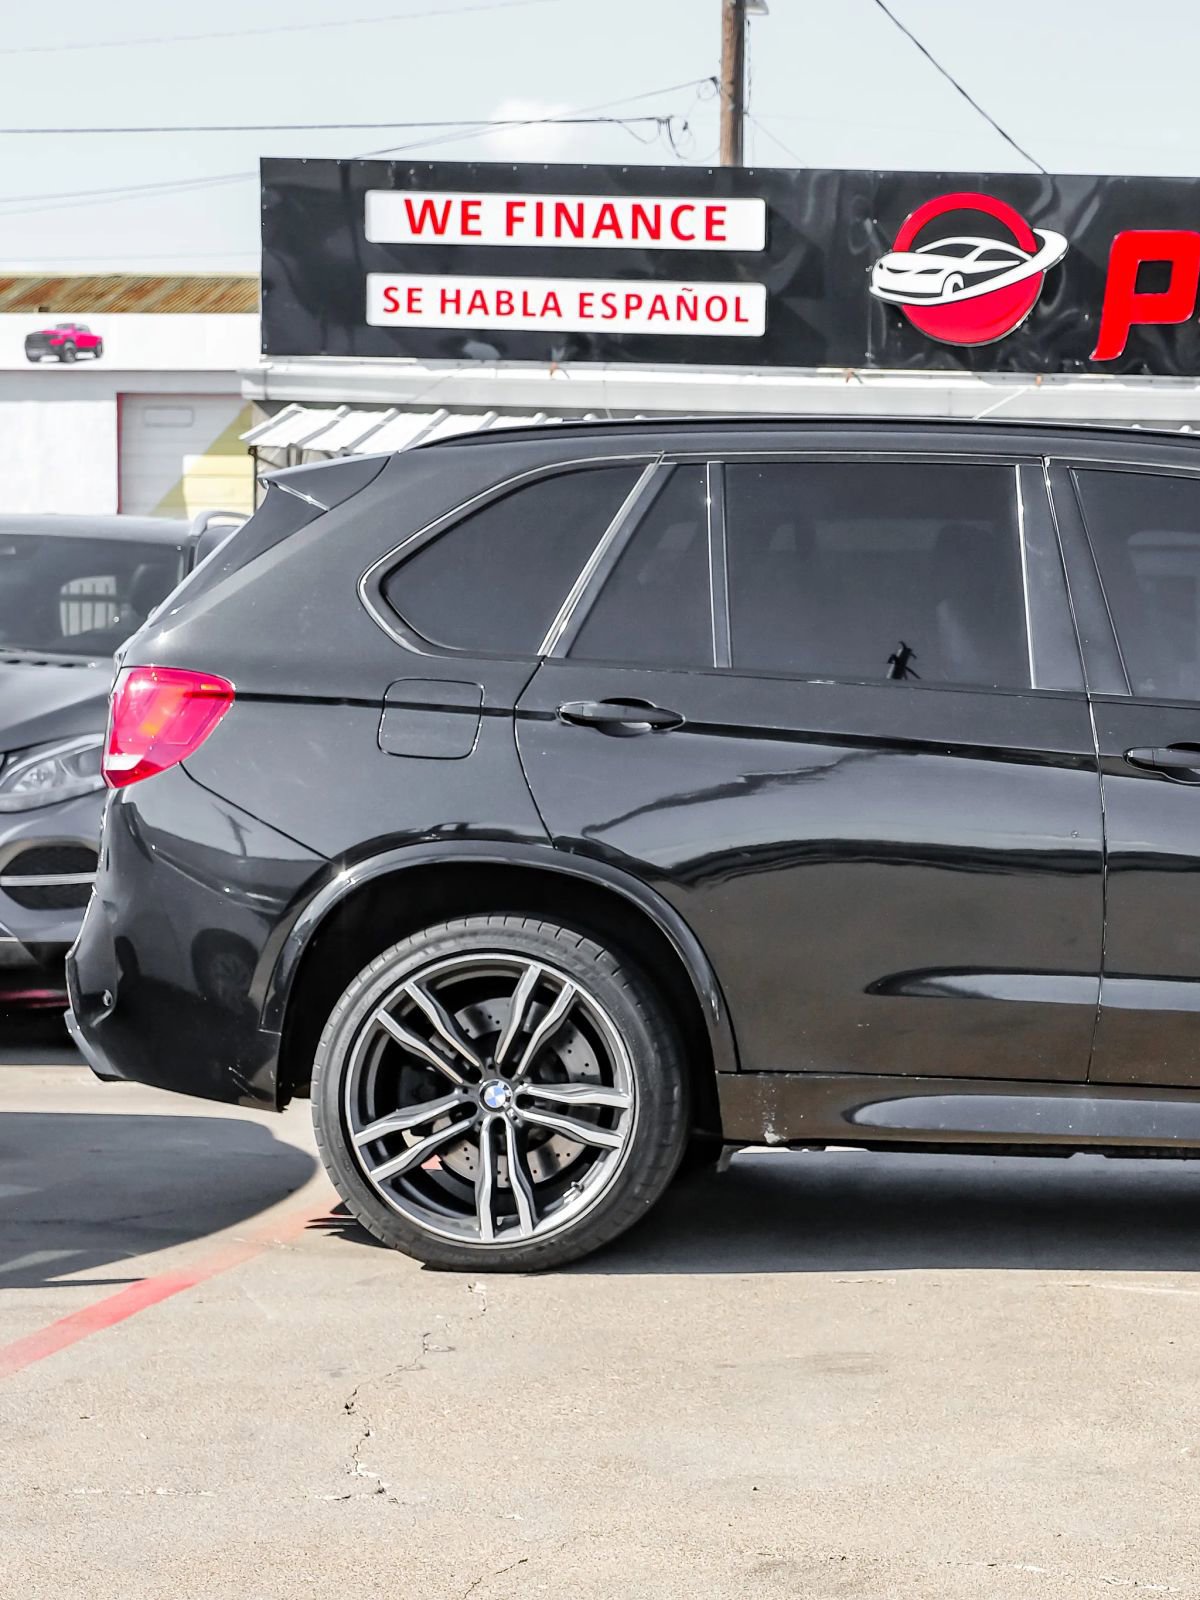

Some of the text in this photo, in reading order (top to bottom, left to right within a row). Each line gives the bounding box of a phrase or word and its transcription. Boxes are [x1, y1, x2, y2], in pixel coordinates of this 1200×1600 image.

[403, 197, 728, 242] WE FINANCE
[382, 285, 750, 323] SE HABLA ESPAÑOL
